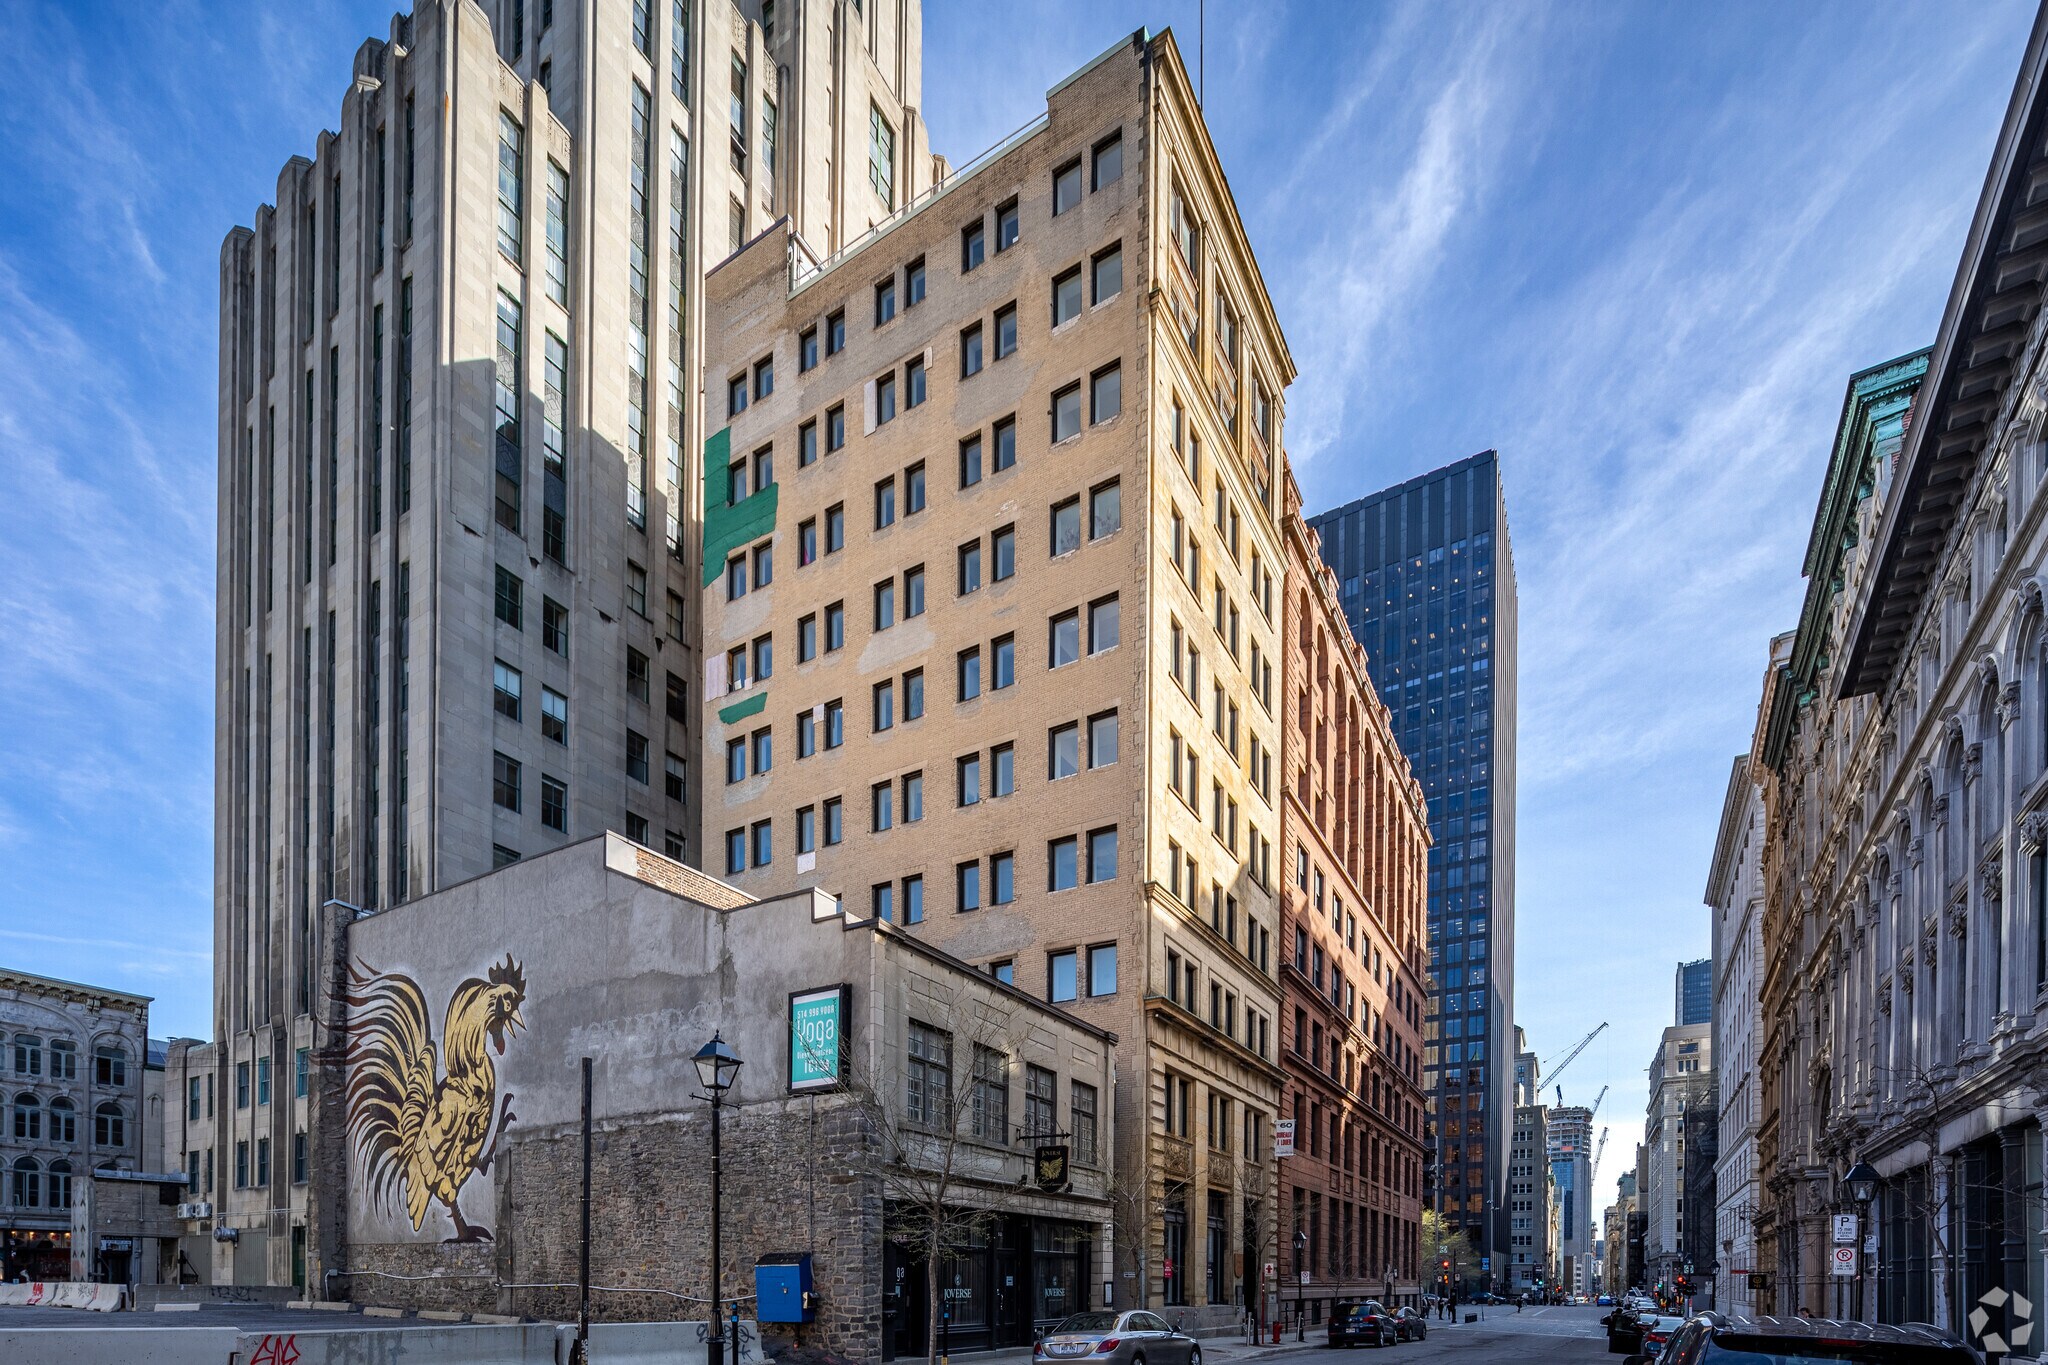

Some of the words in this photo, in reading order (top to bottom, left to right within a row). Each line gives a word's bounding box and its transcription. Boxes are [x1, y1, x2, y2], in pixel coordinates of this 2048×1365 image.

[798, 1019, 834, 1048] Yoga
[1841, 1217, 1850, 1226] P
[944, 1288, 972, 1300] JOVERSE
[1045, 1288, 1065, 1298] JOVERSE
